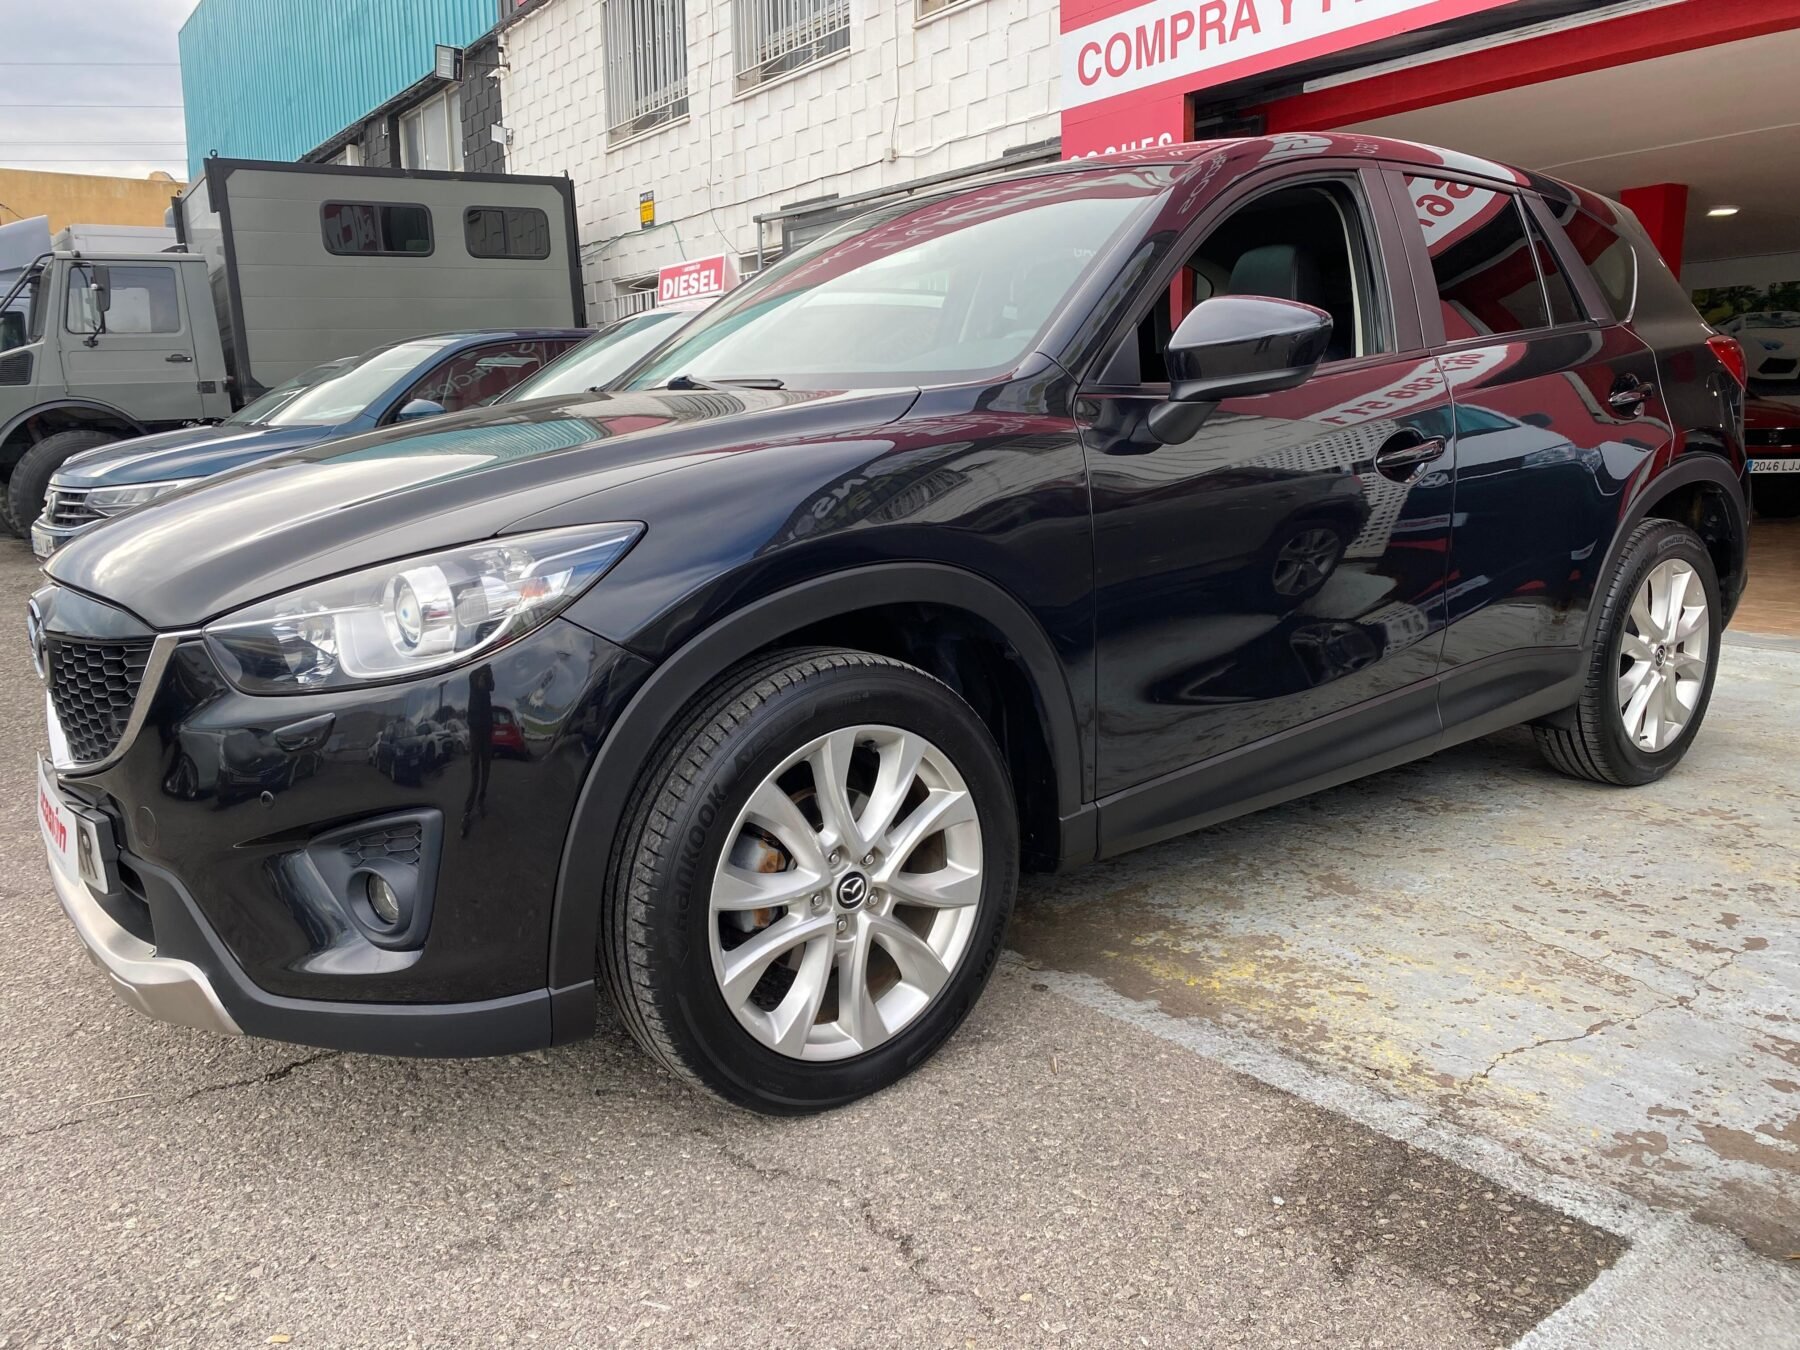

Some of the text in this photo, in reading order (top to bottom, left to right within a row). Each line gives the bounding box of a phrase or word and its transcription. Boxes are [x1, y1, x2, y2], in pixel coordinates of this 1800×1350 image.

[1077, 0, 1262, 87] COMPRA
[662, 268, 719, 300] DIESEL
[1752, 461, 1780, 472] 2046
